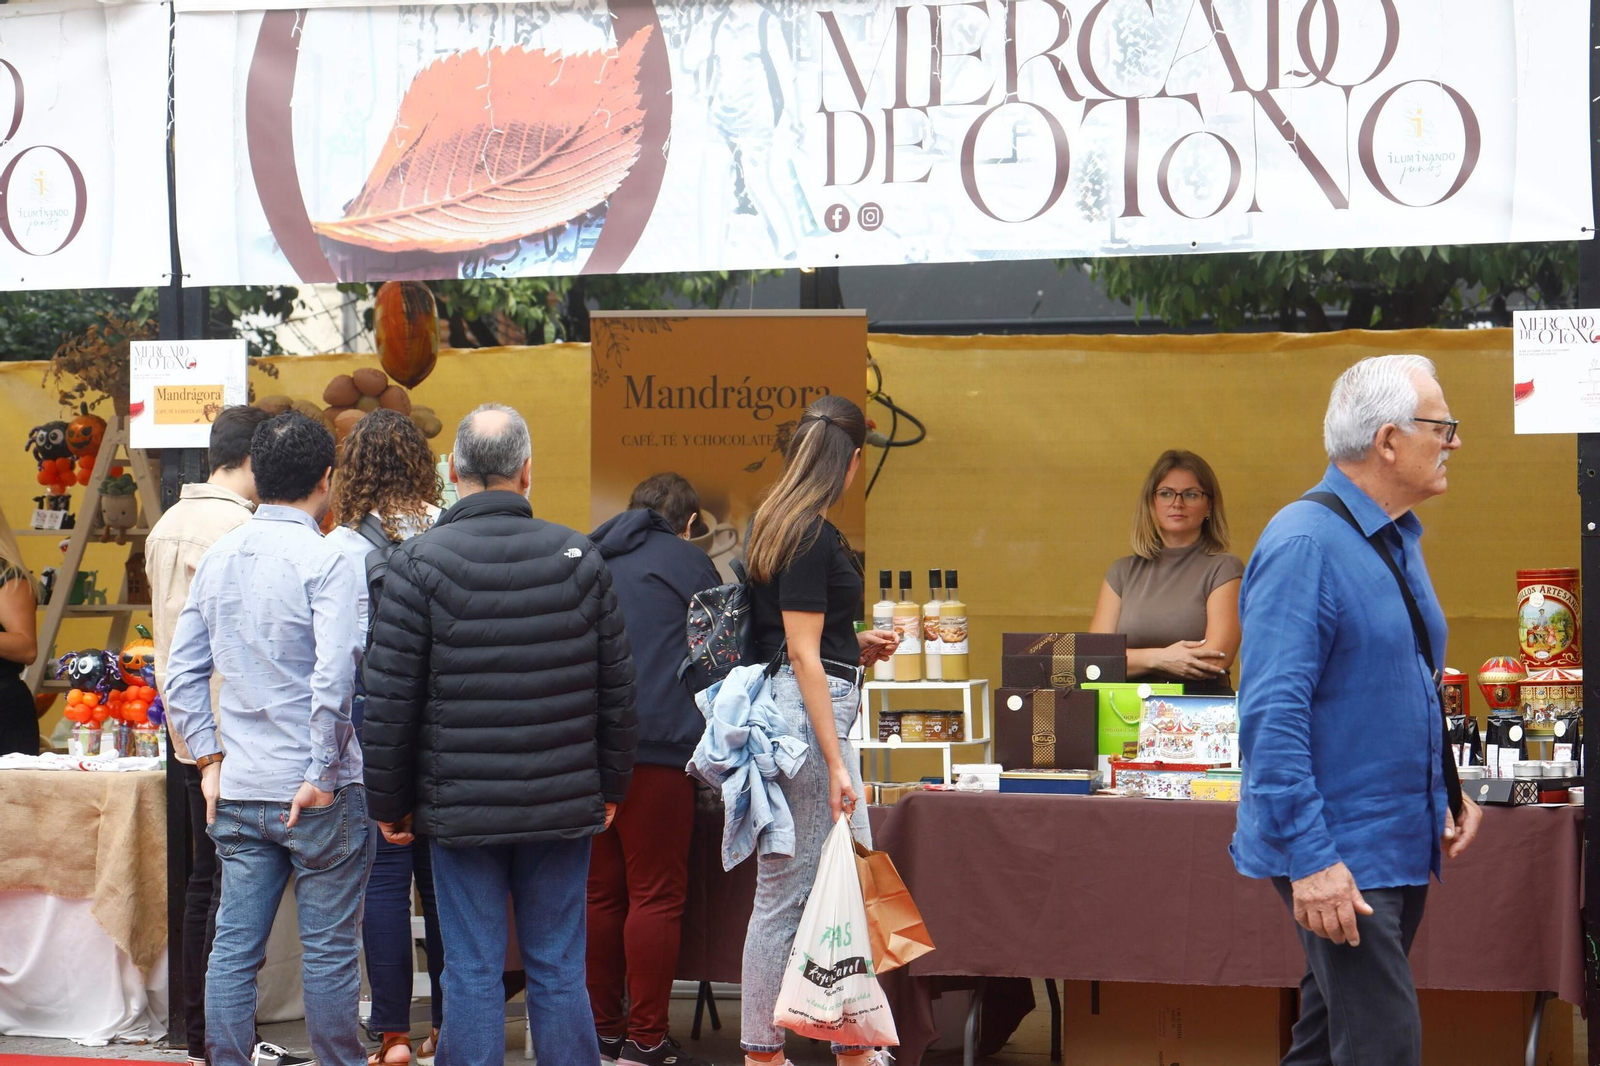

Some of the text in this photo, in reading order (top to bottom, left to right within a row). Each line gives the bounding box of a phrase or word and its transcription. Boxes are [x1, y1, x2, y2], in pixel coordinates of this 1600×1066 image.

[816, 0, 1400, 113] MERCADO
[816, 104, 935, 187] DE
[157, 388, 221, 404] Mandrágora
[660, 432, 678, 446] TÉ
